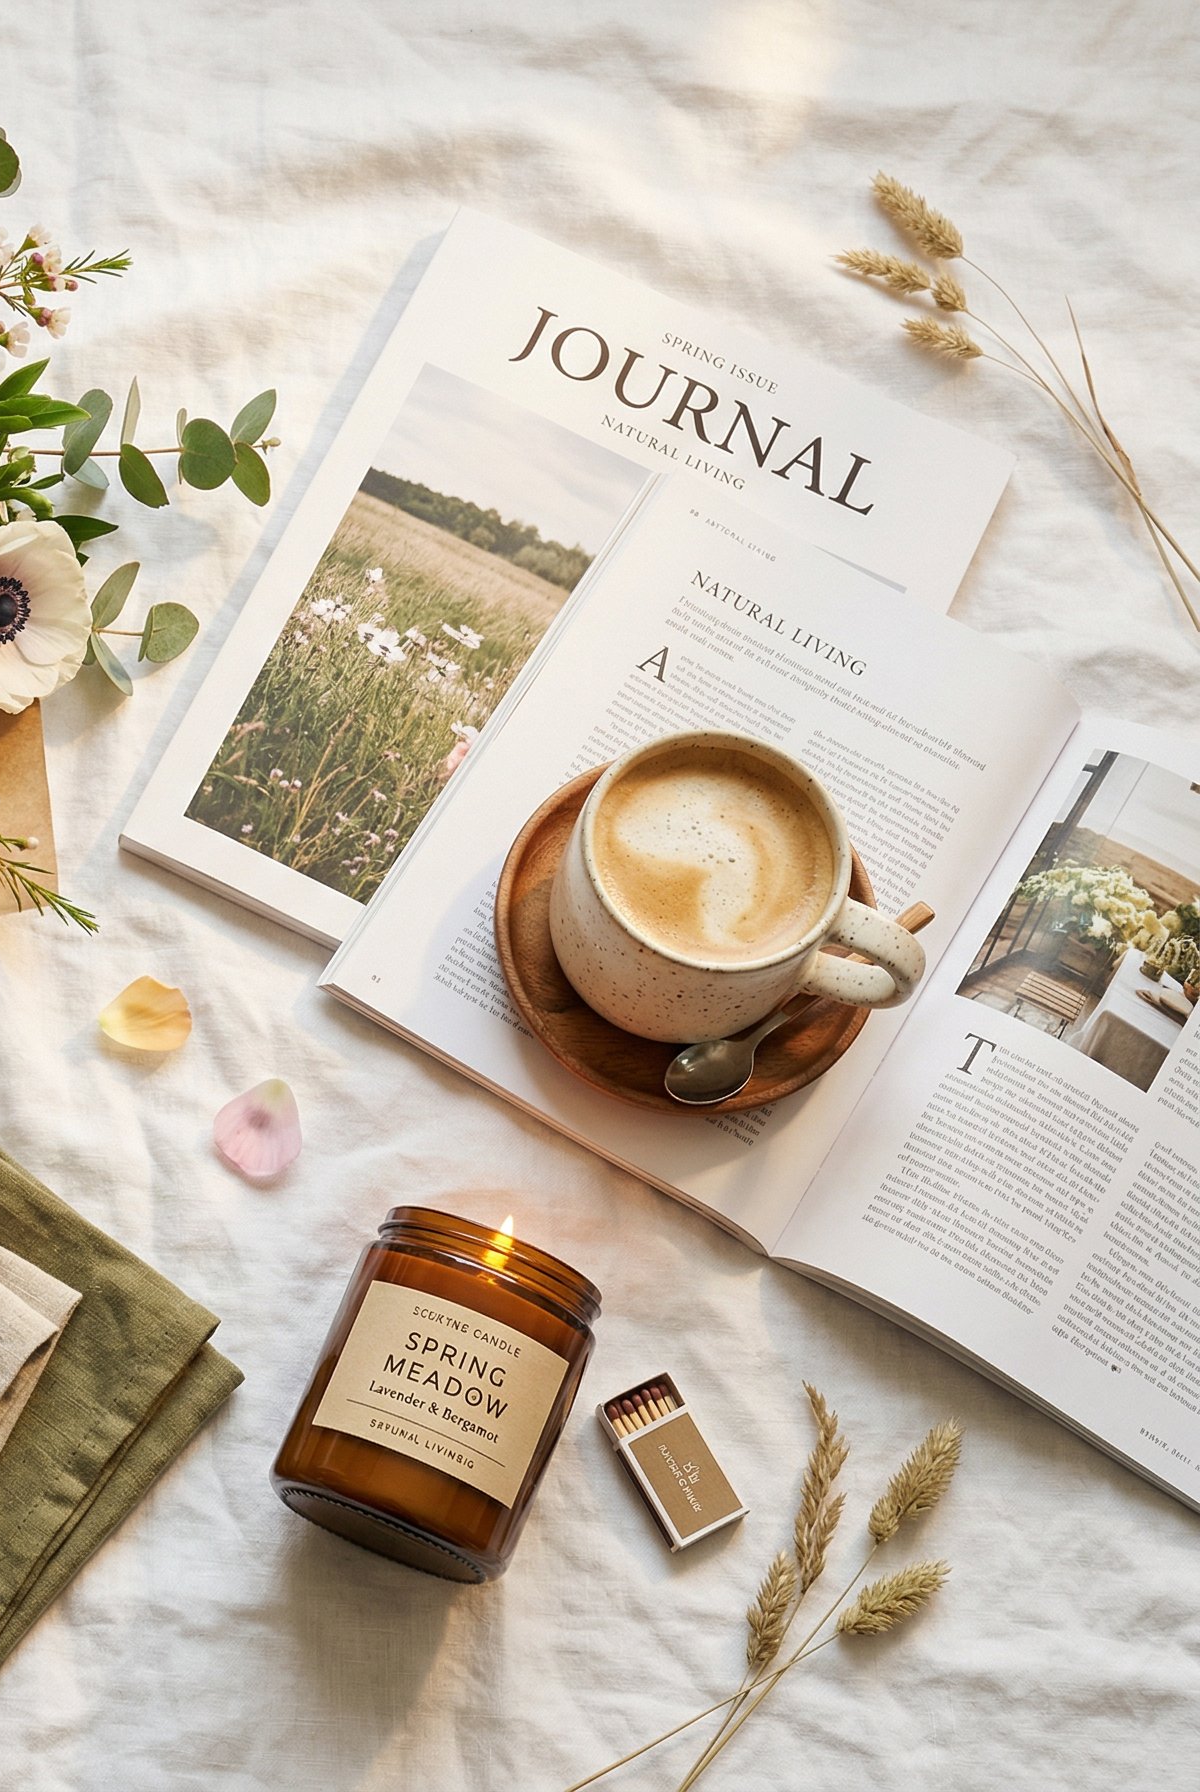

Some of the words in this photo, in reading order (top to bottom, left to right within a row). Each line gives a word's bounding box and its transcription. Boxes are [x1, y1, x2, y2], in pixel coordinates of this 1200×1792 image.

[661, 332, 726, 369] SPRING
[729, 364, 779, 395] ISSUE
[508, 306, 875, 516] JOURNAL
[601, 414, 680, 461] NATURAL
[684, 454, 746, 491] LIVING
[690, 570, 785, 635] NATURAL
[791, 628, 867, 677] LIVING
[636, 646, 669, 683] A
[956, 1032, 997, 1076] T
[405, 1331, 506, 1387] SPRING
[473, 1329, 521, 1358] CANDLE
[369, 1380, 426, 1409] Lavender
[428, 1402, 440, 1415] &
[442, 1407, 500, 1444] Bergamot
[383, 1354, 509, 1419] MEADOW
